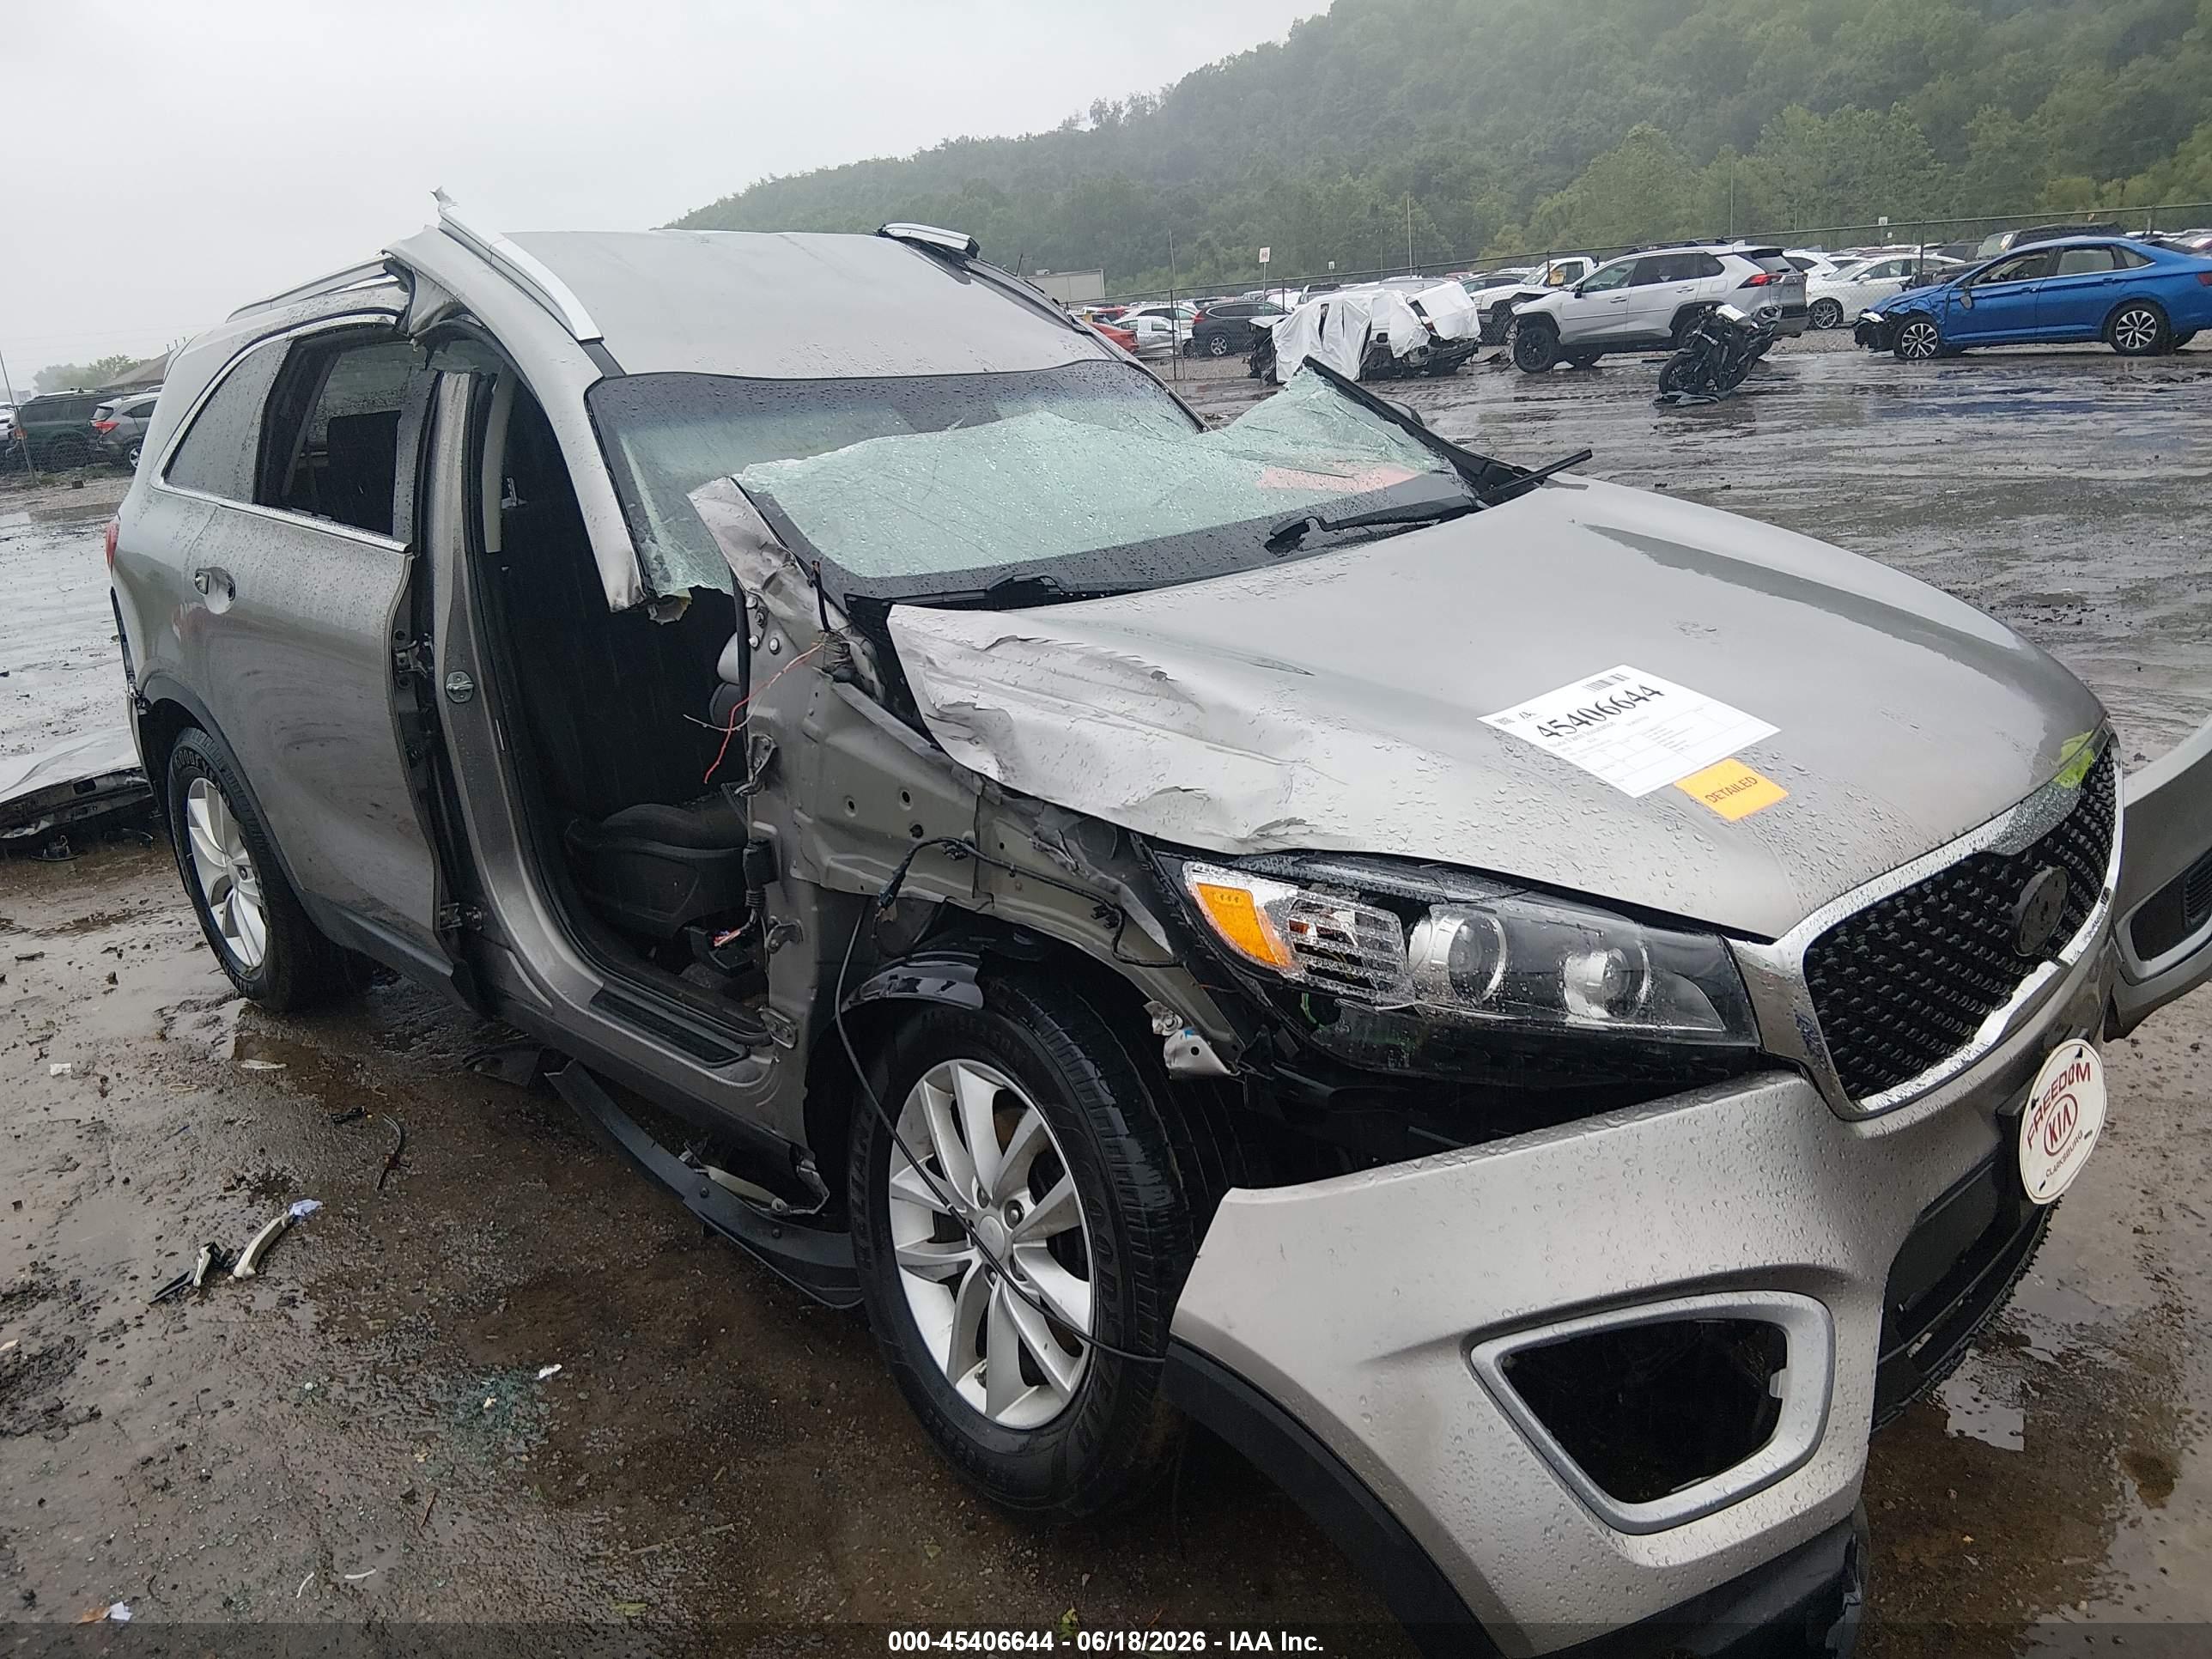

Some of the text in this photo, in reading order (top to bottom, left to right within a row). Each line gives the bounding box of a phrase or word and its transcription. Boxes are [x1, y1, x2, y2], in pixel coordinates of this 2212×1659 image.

[1536, 684, 1665, 738] 45406644
[1704, 775, 1759, 804] DETAILED
[2027, 1061, 2092, 1152] FREEDOM
[2048, 1103, 2073, 1149] KIA
[2045, 1129, 2083, 1177] CLARKSBURG
